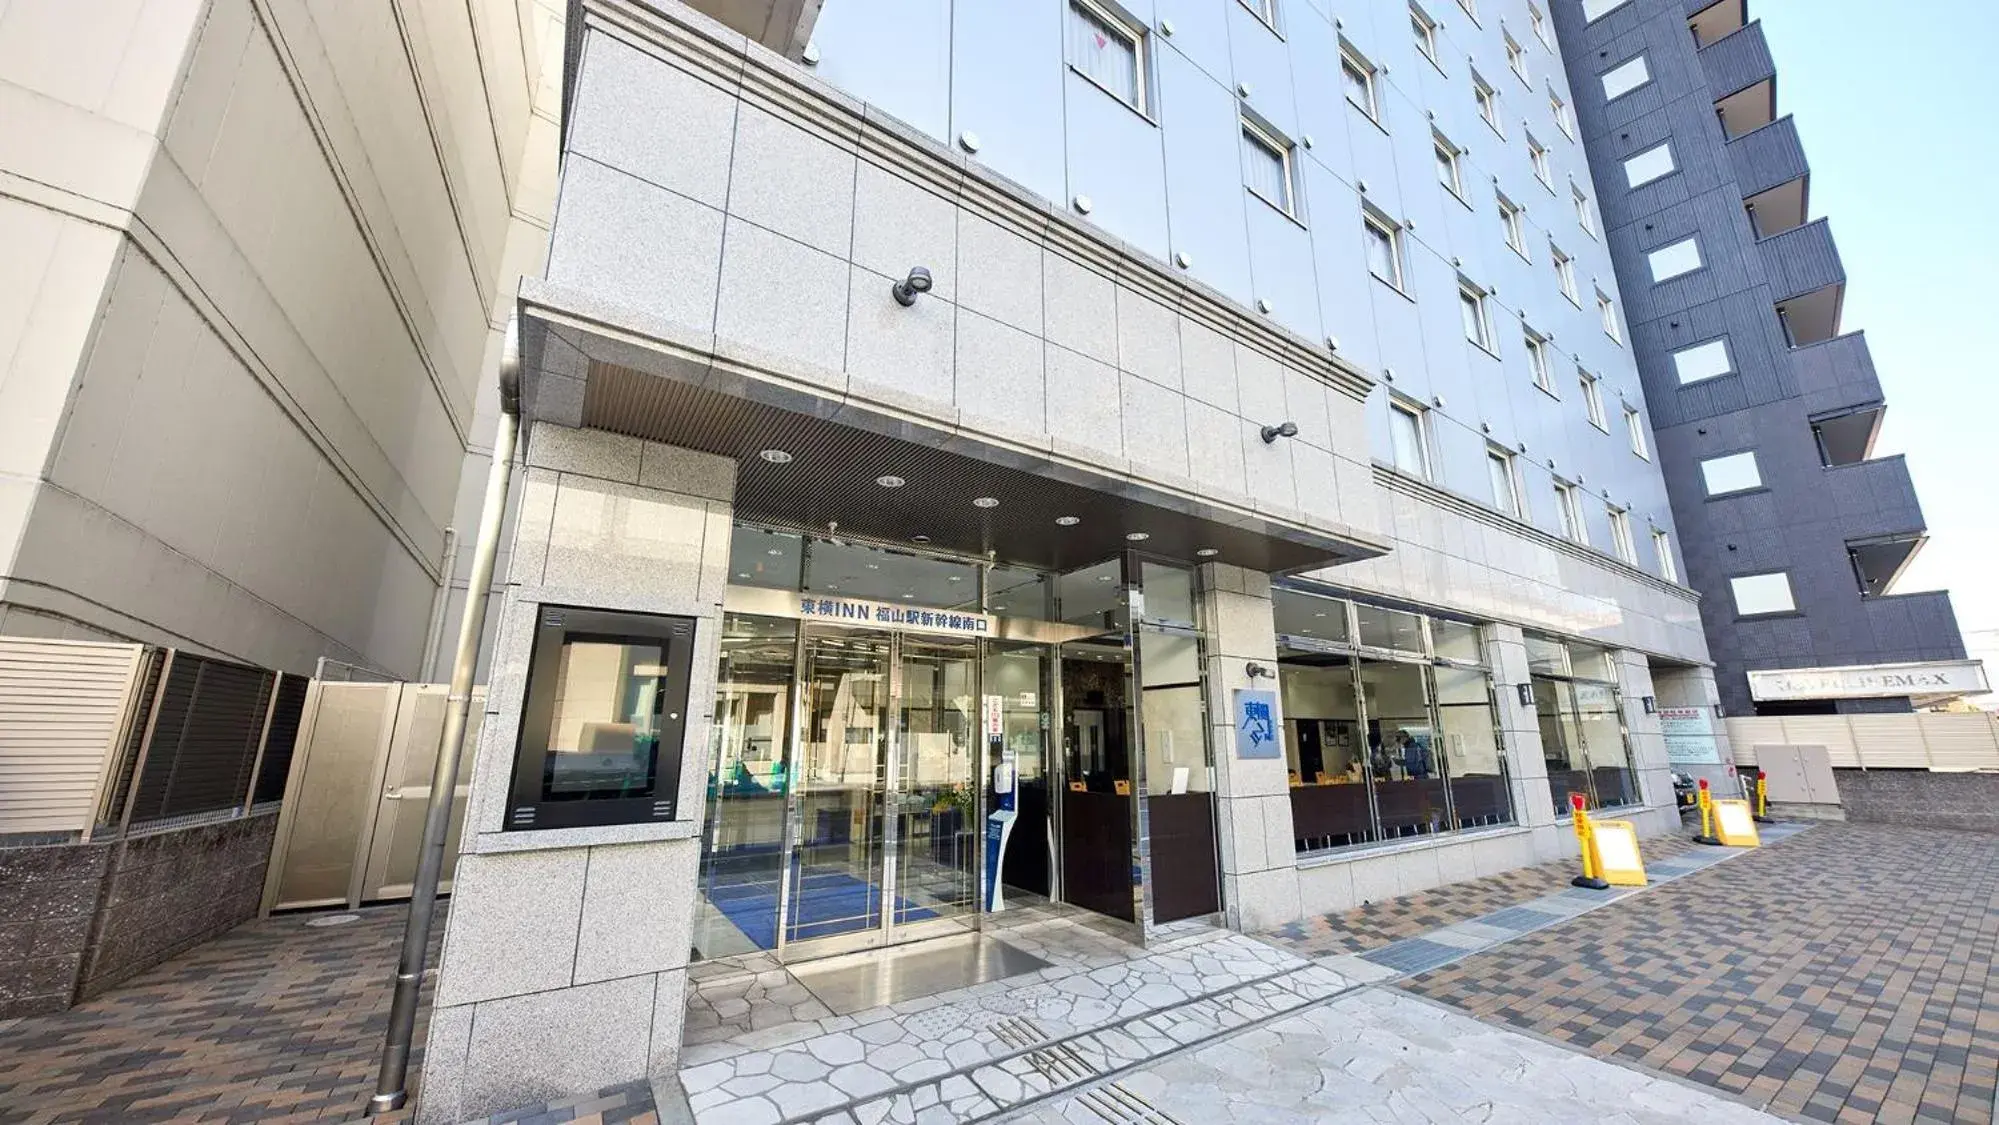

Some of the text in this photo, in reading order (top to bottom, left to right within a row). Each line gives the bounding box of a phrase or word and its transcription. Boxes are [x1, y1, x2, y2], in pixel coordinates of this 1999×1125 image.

[801, 599, 987, 632] 東横INN 福山駅新幹線南口
